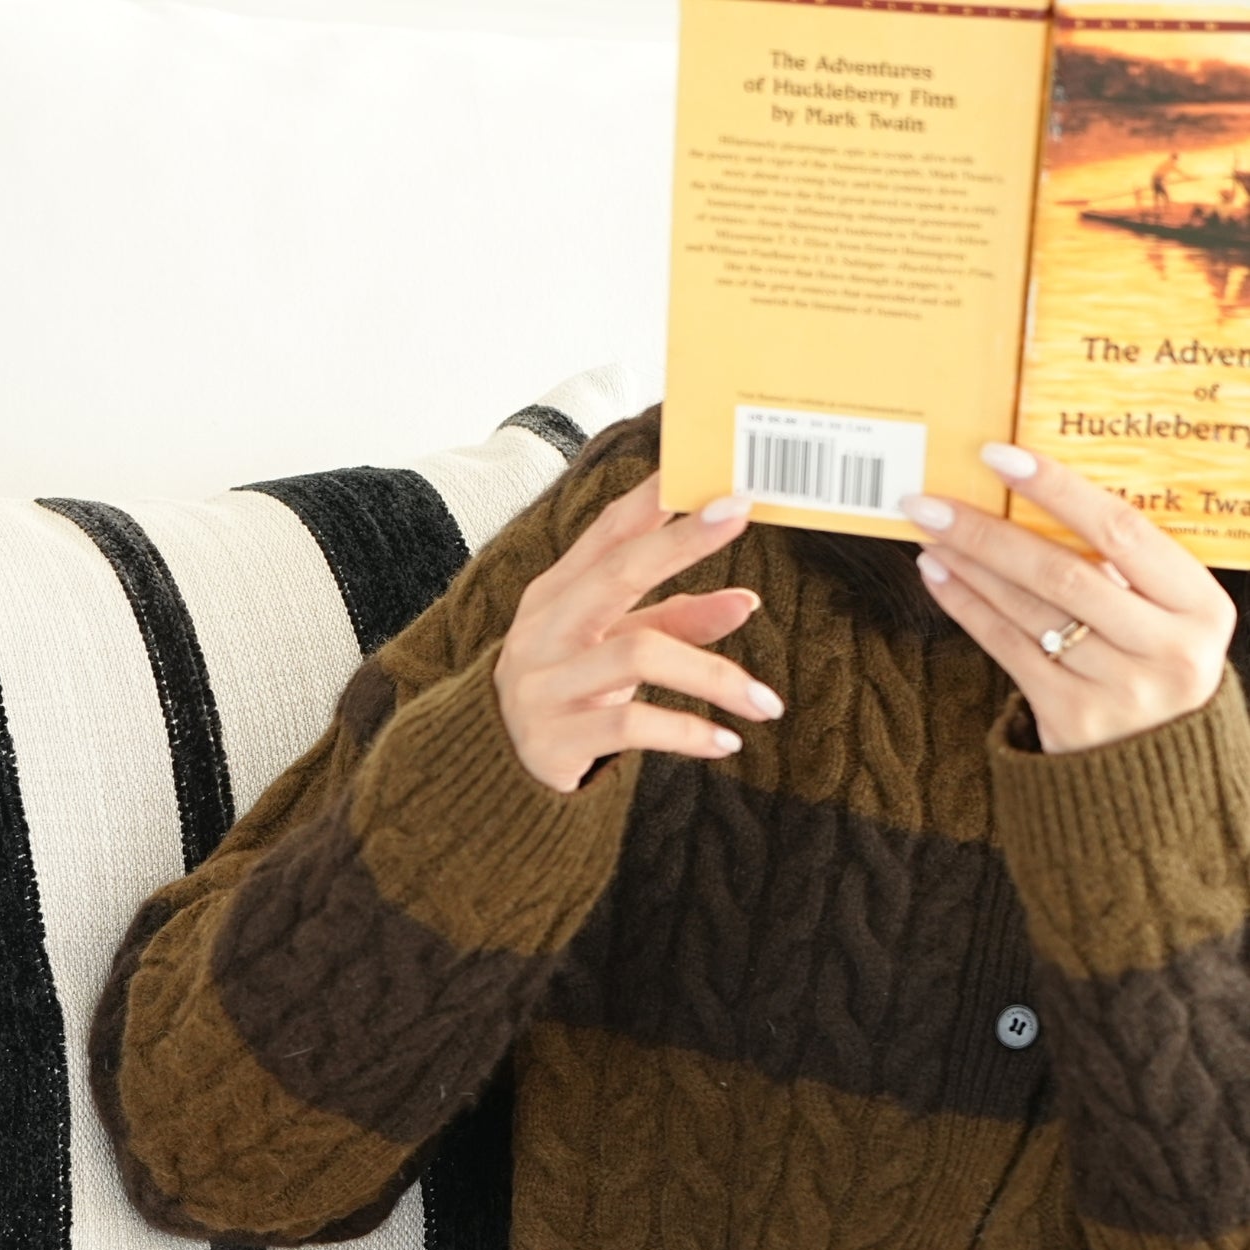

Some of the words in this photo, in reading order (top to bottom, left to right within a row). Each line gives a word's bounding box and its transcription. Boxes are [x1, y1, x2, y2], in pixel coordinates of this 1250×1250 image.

[770, 50, 807, 71] The
[815, 56, 934, 80] Adventures
[743, 77, 765, 94] of
[773, 78, 901, 108] Huckleberry
[909, 88, 958, 109] Finn
[770, 104, 795, 126] by
[805, 105, 860, 128] Mark
[869, 111, 927, 133] Twain
[1082, 335, 1142, 363] The
[1193, 383, 1220, 402] of
